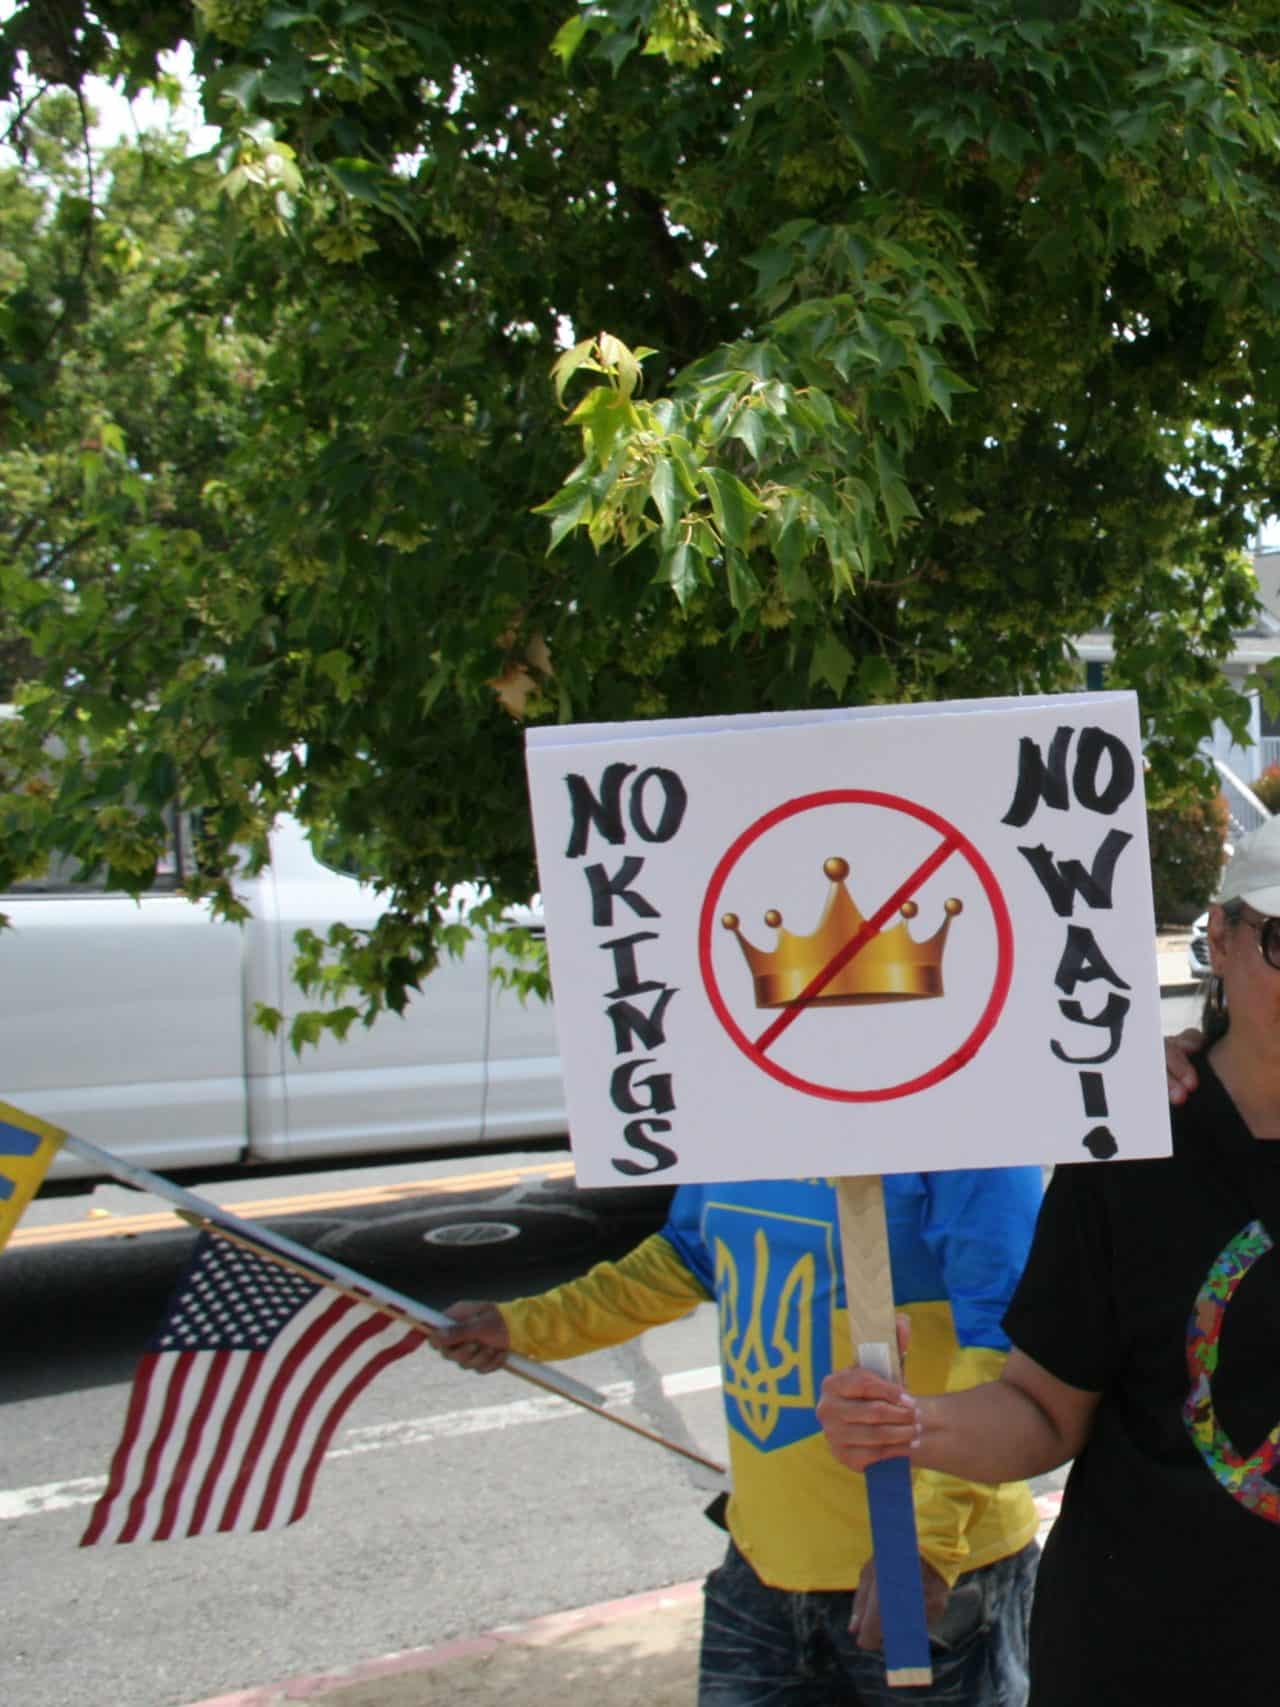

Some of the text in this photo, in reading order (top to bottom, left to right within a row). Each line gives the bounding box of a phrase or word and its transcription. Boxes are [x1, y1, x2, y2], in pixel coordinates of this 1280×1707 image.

[565, 763, 687, 858] NO
[1002, 726, 1135, 827] NO
[584, 856, 678, 1175] KINGS
[1018, 829, 1132, 1160] WAY!
